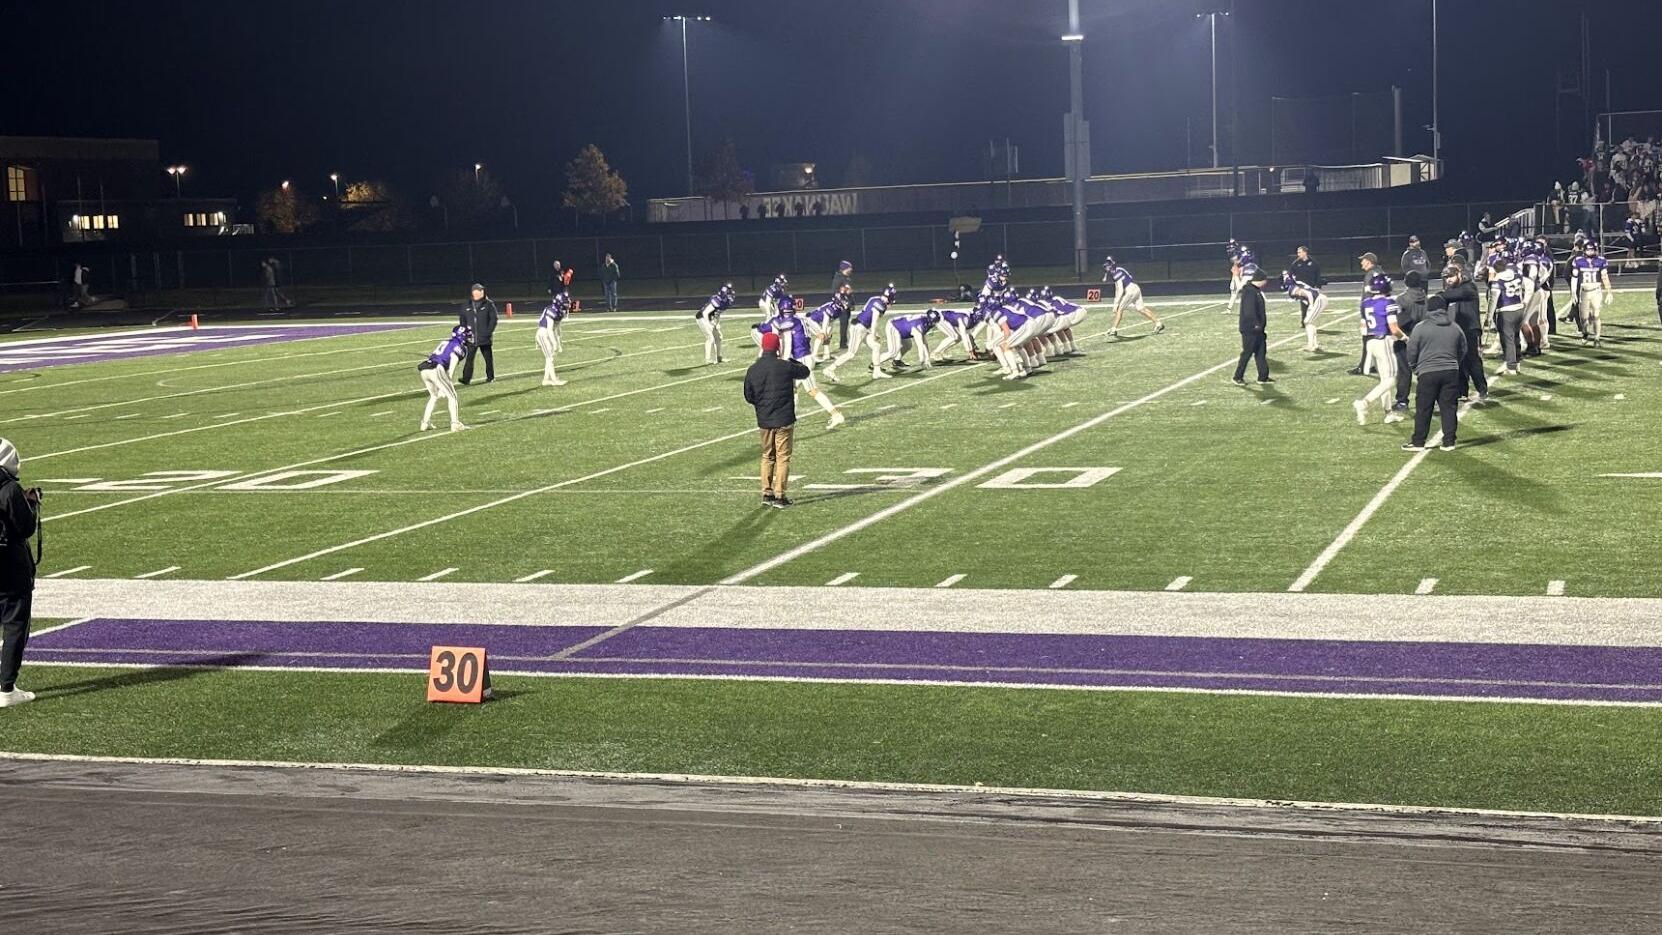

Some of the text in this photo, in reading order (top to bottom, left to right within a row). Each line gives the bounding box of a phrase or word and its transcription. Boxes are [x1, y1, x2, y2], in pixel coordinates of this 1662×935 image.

[1583, 271, 1597, 283] 81
[1088, 291, 1099, 300] 20
[1364, 307, 1377, 329] 5
[433, 650, 479, 694] 30
